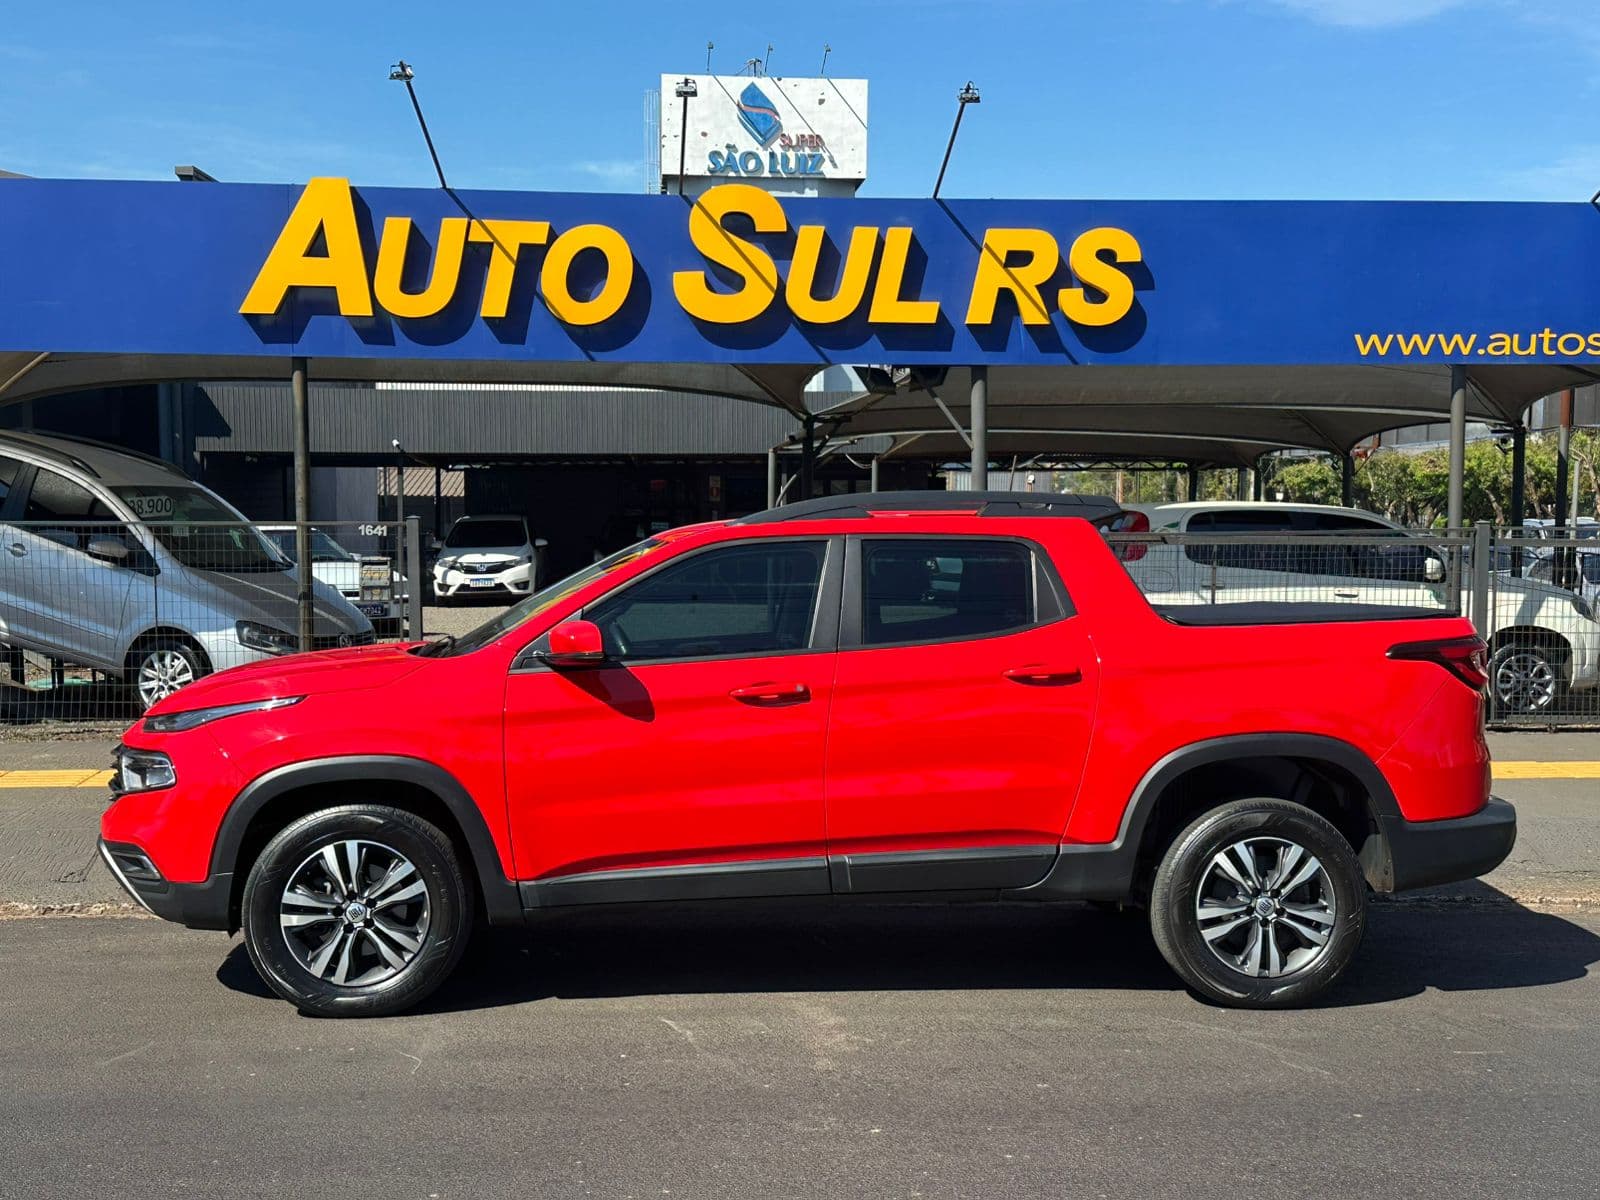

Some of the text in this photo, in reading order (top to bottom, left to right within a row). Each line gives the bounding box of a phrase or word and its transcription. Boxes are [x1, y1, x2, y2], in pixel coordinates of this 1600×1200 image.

[780, 133, 825, 149] SUPER
[707, 143, 826, 175] SÃO LUIZ
[238, 176, 1142, 327] AUTO SUL RS
[1354, 328, 1600, 356] www.autos
[358, 524, 388, 536] 1641
